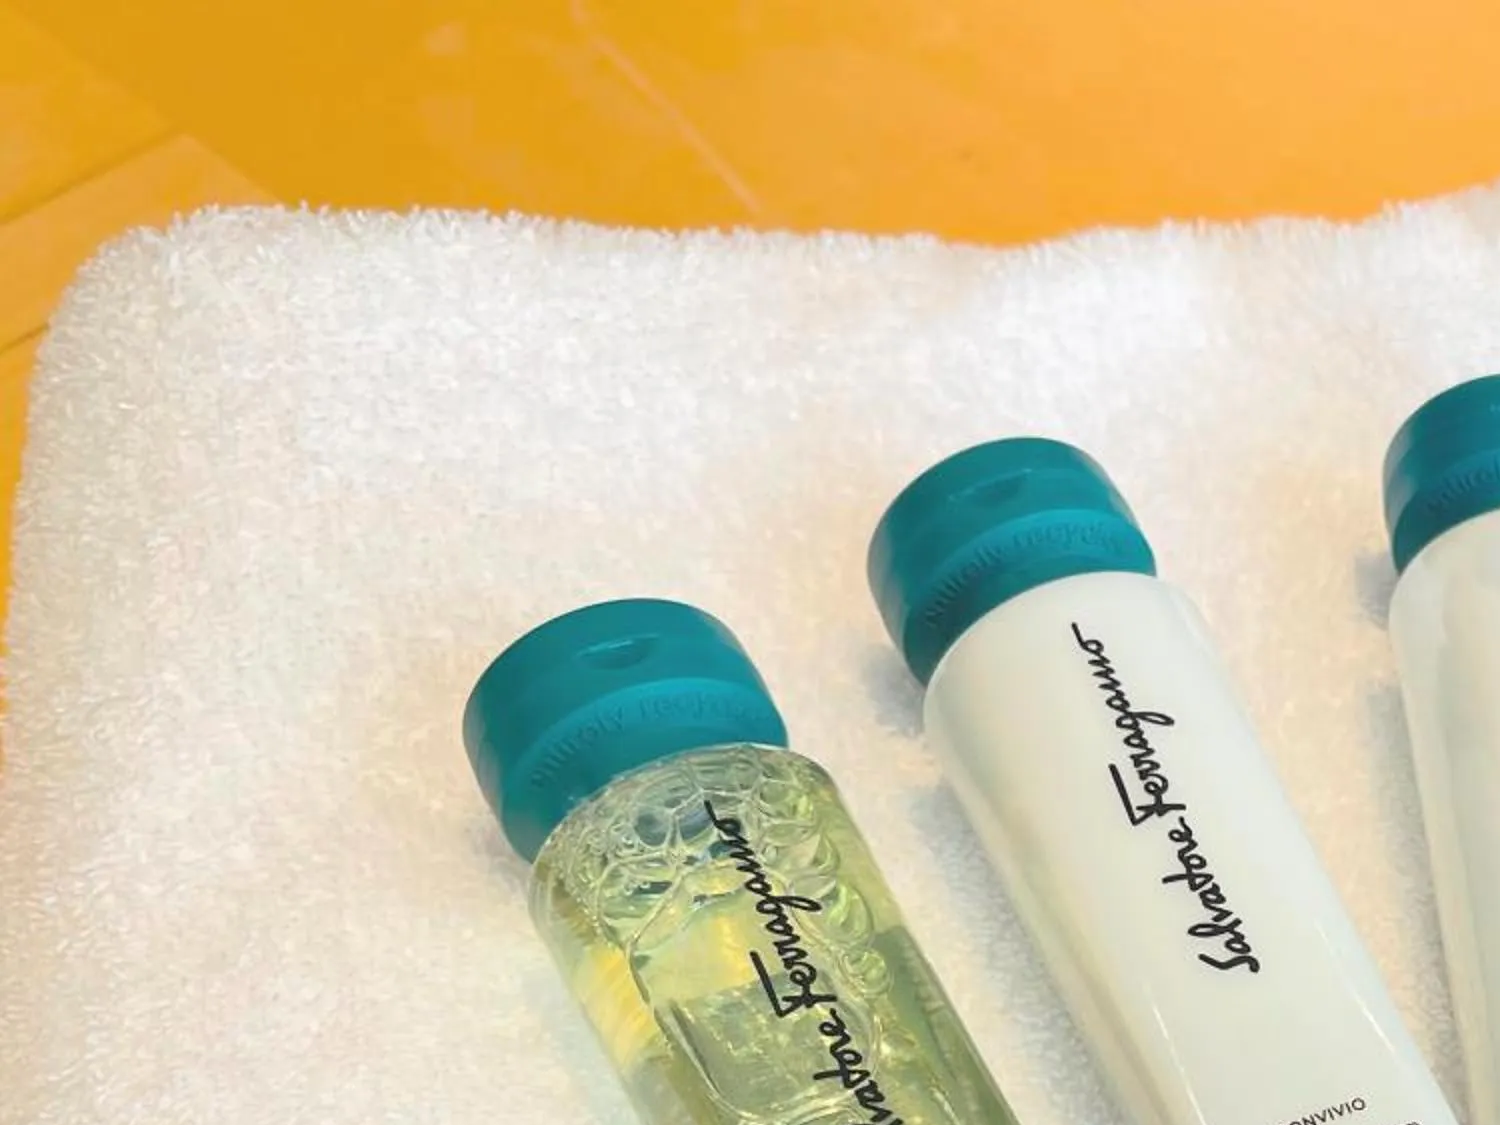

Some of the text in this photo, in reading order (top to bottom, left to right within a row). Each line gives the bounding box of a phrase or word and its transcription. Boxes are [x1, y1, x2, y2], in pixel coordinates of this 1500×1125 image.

[703, 799, 838, 1018] Ferragamo
[1071, 621, 1260, 974] Salvatore Ferragamo
